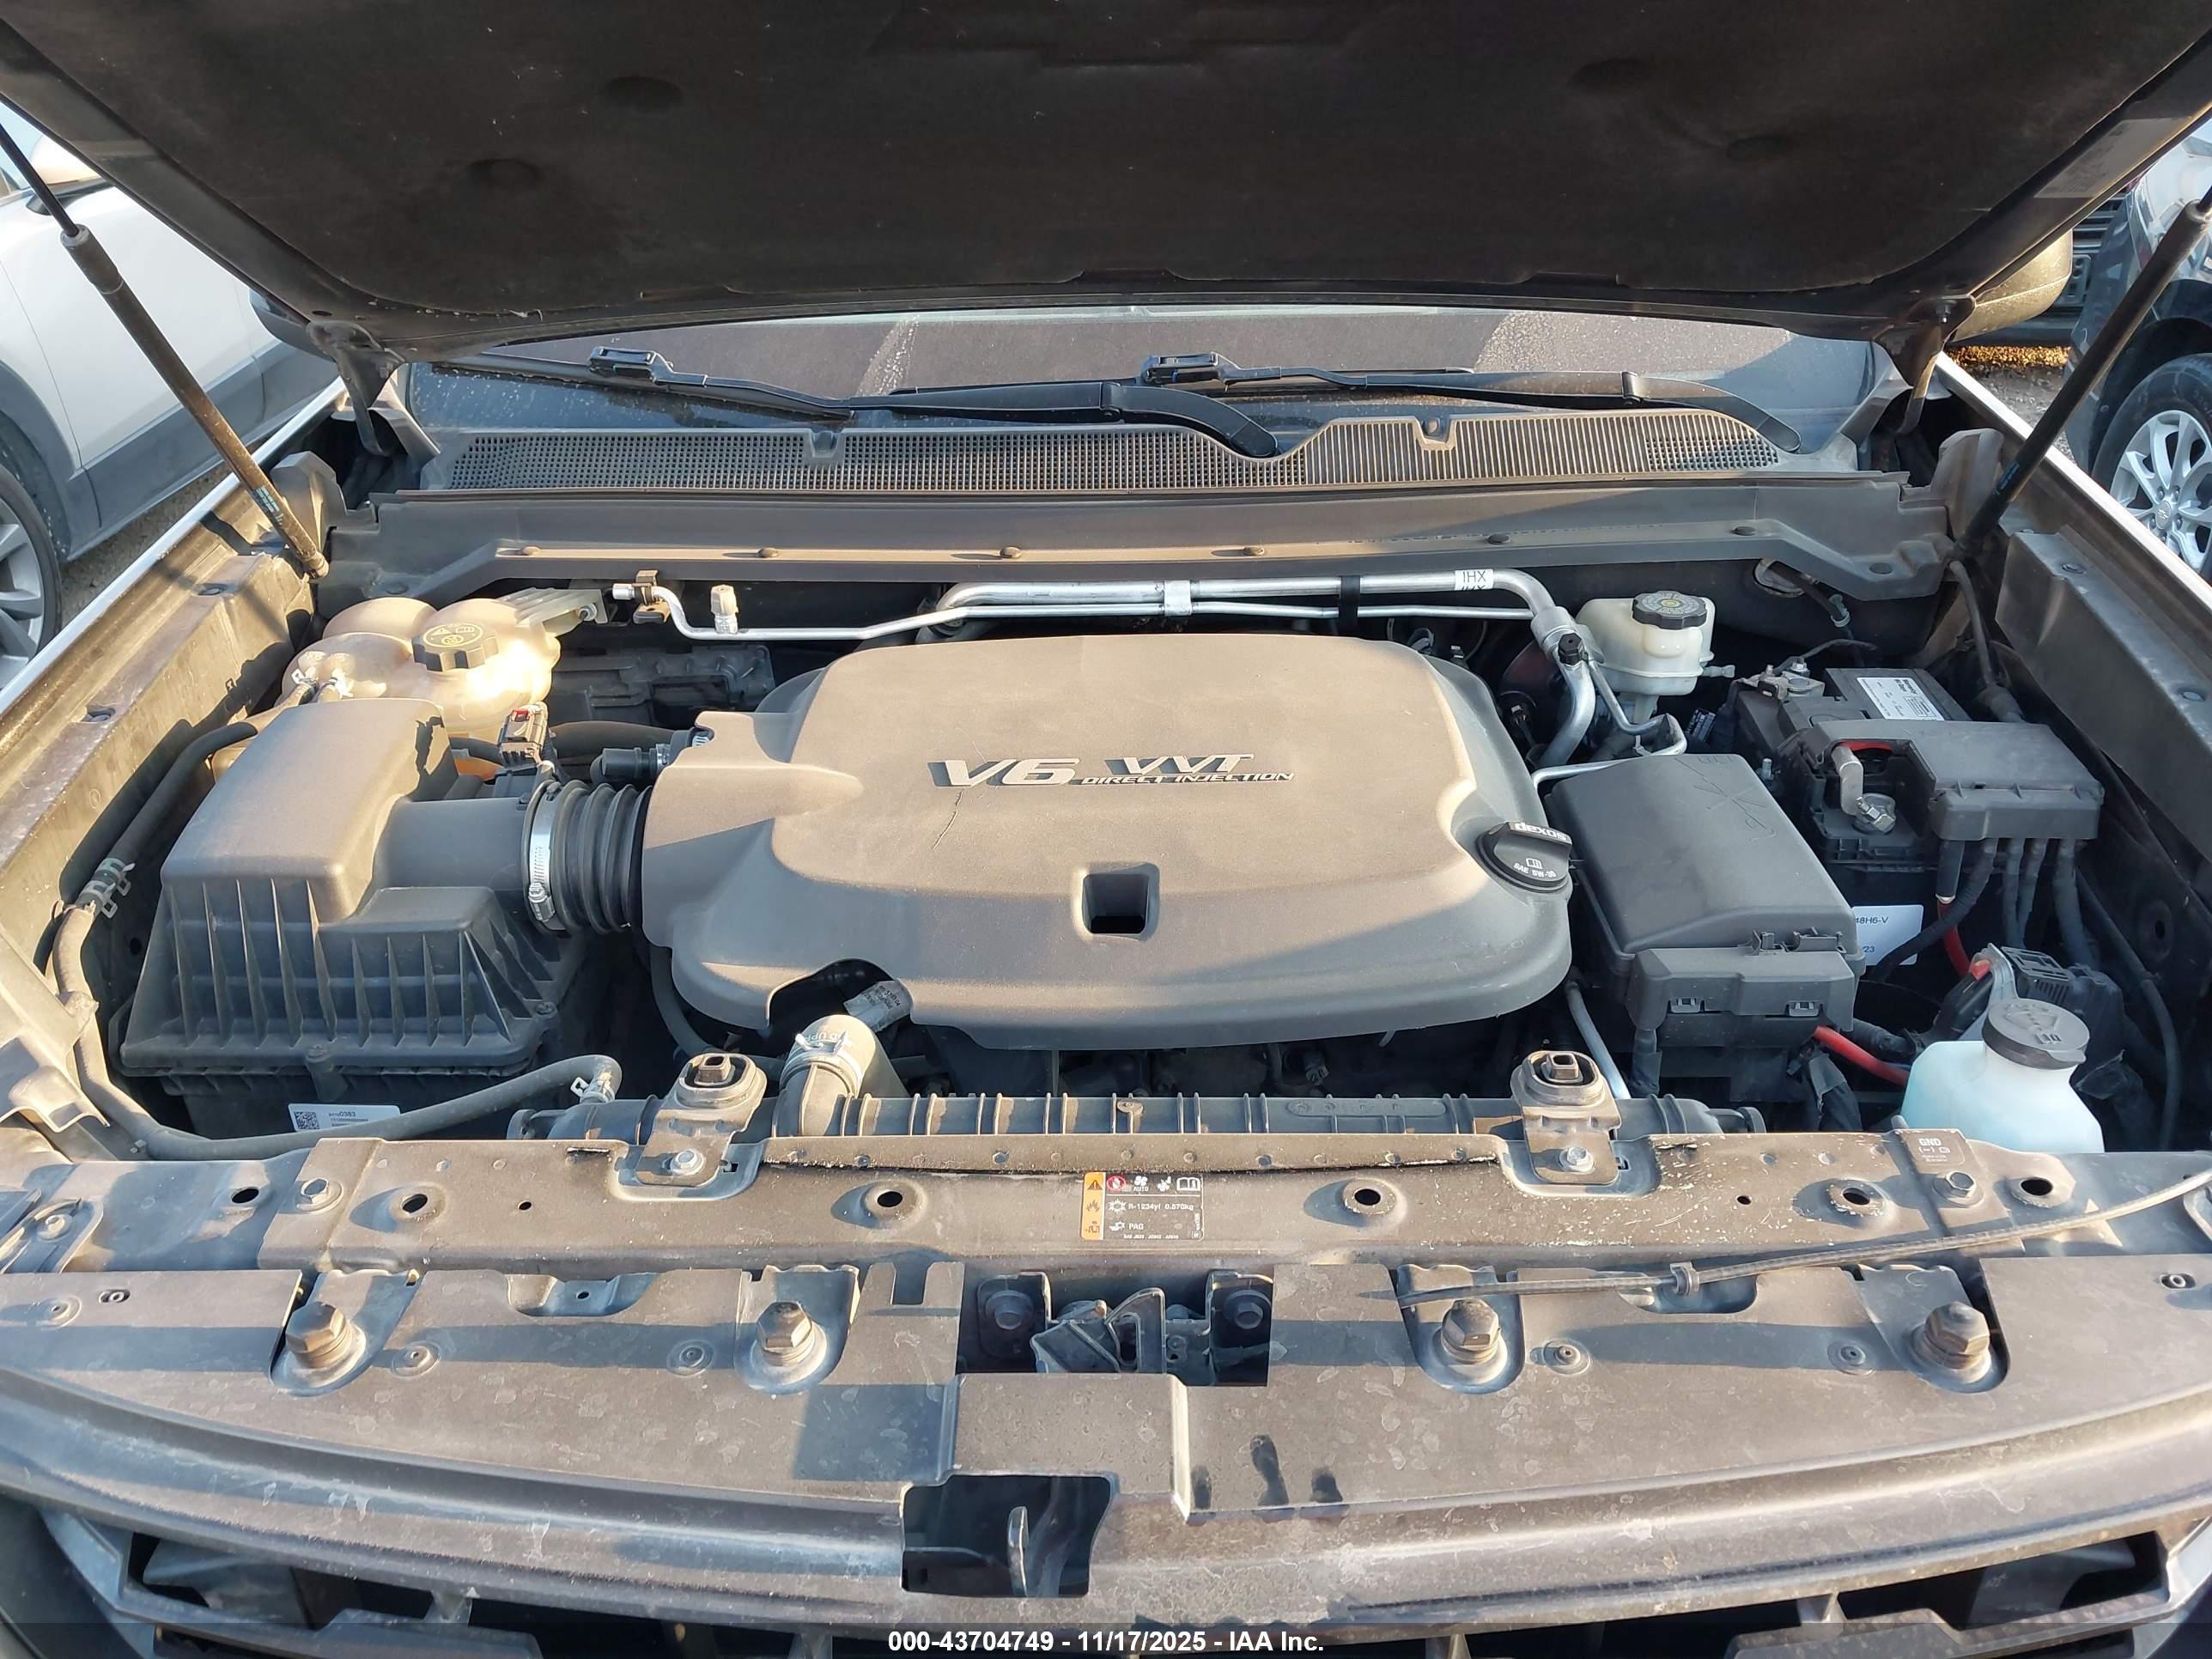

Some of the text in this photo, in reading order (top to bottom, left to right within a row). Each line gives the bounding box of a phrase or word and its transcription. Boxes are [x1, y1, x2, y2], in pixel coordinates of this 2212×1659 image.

[929, 758, 1080, 787] V6
[1115, 754, 1254, 775] VVT
[1081, 773, 1294, 785] DIRECT INJECTION
[1514, 822, 1567, 842] dexos
[1918, 1138, 1942, 1146] GND
